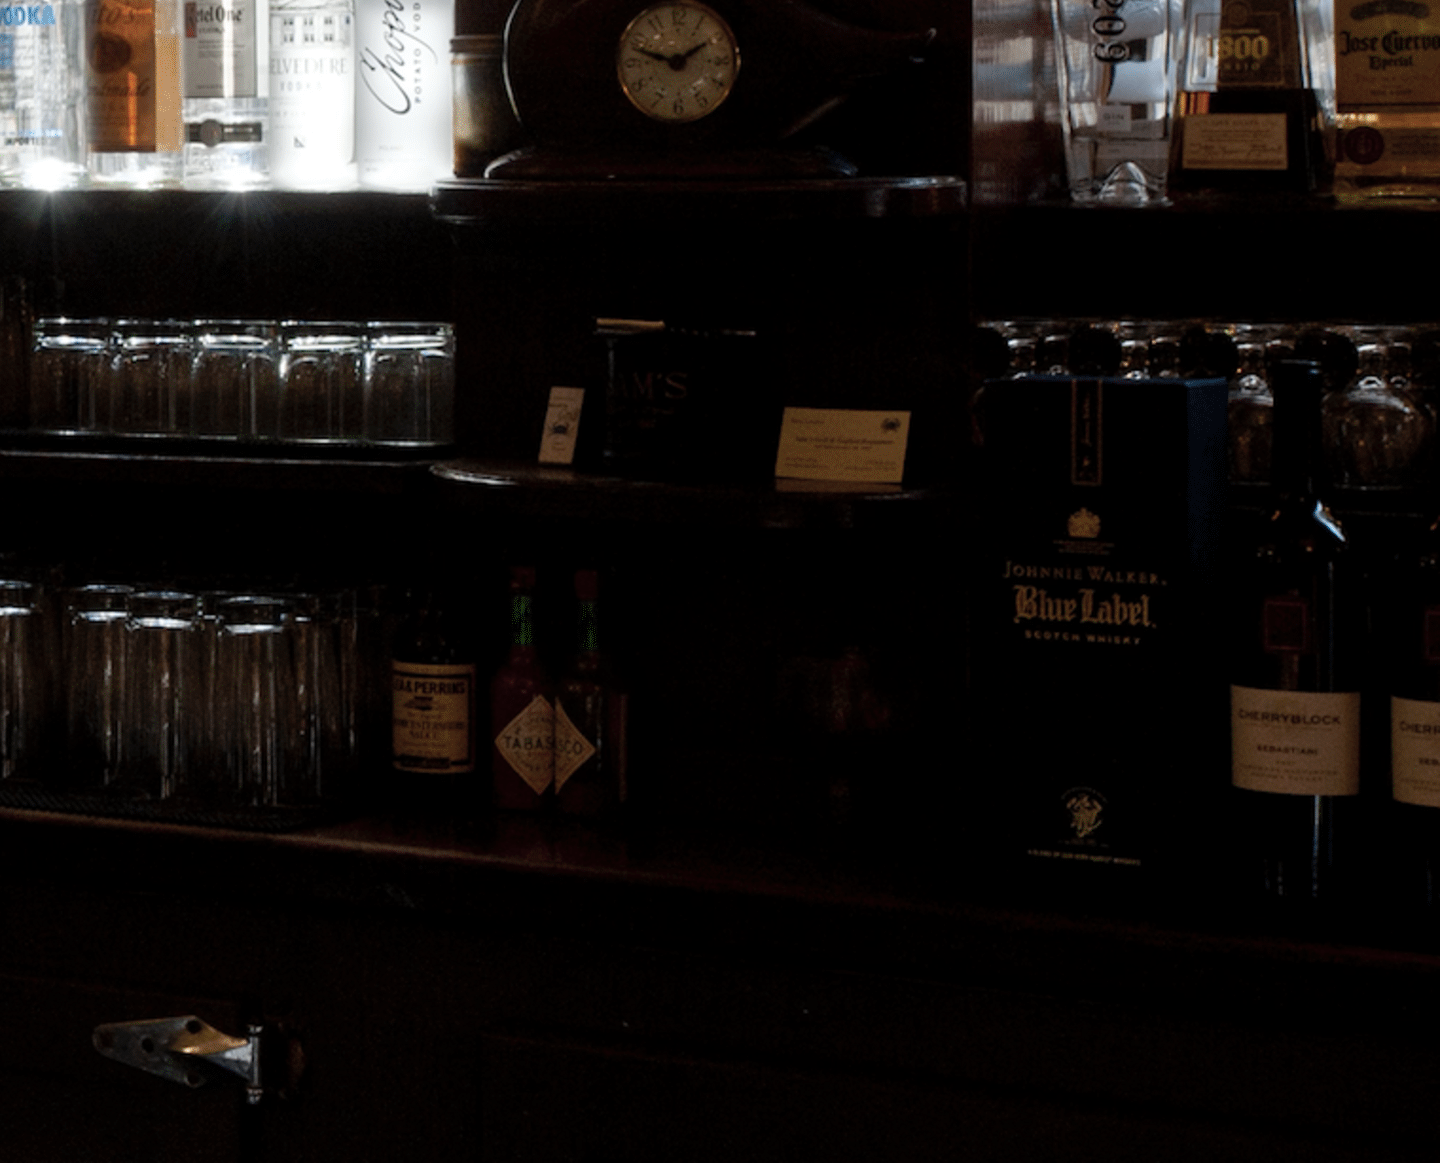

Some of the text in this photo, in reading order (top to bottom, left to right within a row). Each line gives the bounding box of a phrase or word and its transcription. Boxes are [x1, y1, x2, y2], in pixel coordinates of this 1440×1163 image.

[1340, 29, 1378, 56] Jose
[270, 57, 348, 76] ELVEDERE
[413, 48, 422, 104] POTATO
[611, 371, 689, 401] AM'S
[1002, 559, 1084, 581] JOHNNIE
[1012, 584, 1078, 625] Blue
[1024, 629, 1142, 646] SCOTCH WHISKY
[1238, 708, 1341, 726] CHERRYBLOCK
